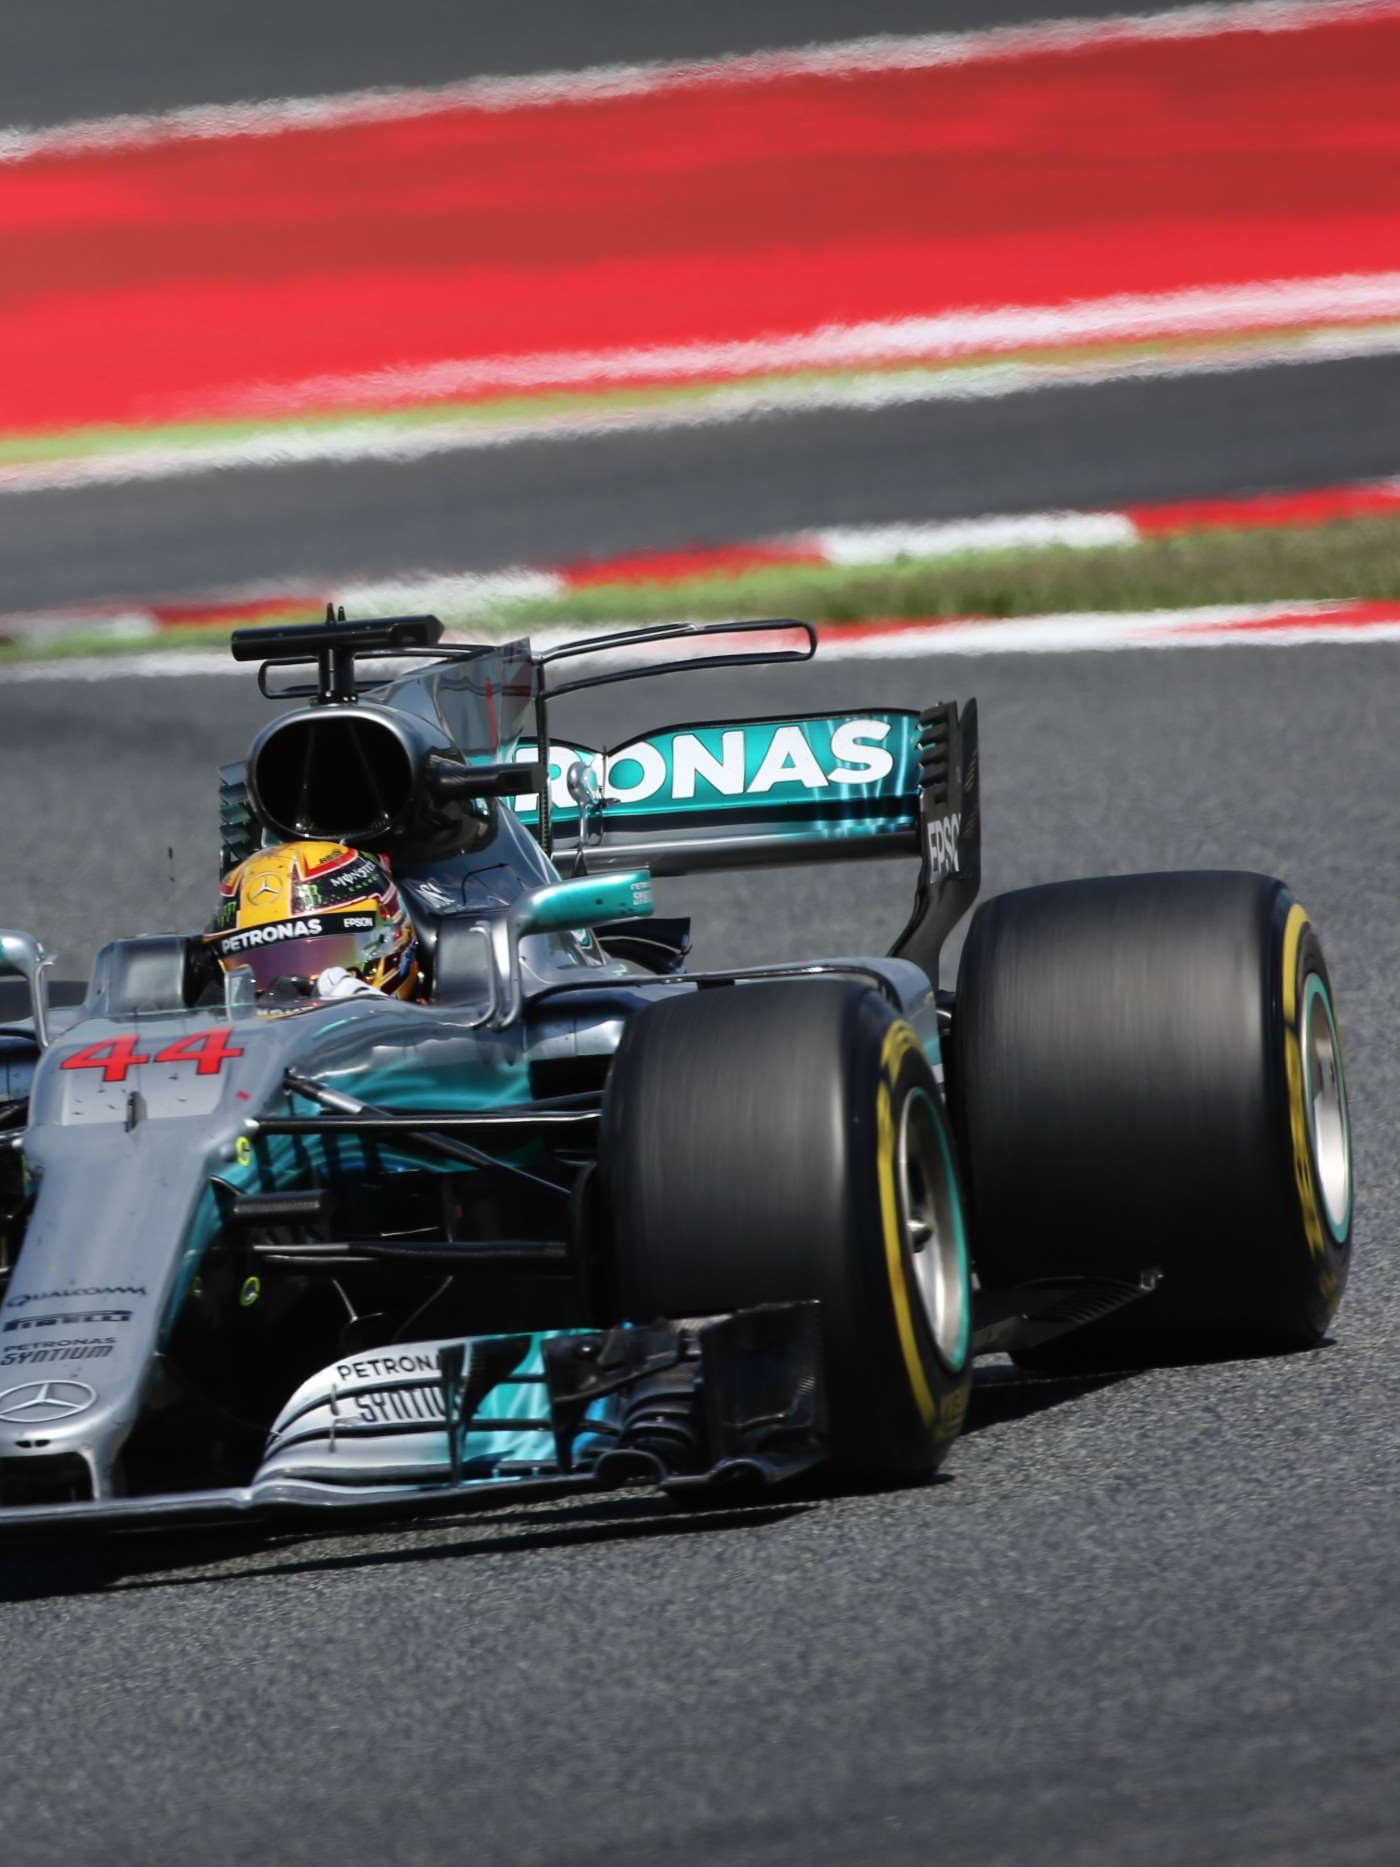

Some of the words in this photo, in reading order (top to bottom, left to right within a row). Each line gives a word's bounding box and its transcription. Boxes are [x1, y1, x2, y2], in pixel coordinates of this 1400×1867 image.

[344, 917, 373, 927] EPSON
[221, 919, 322, 953] PETRONAS
[60, 1026, 245, 1082] 44
[6, 1286, 147, 1308] QUALCOMM
[2, 1310, 133, 1332] PIRELLI
[0, 1345, 114, 1366] SYNTIUM
[3, 1337, 117, 1352] PETRONAS
[337, 1355, 442, 1381] PETRON
